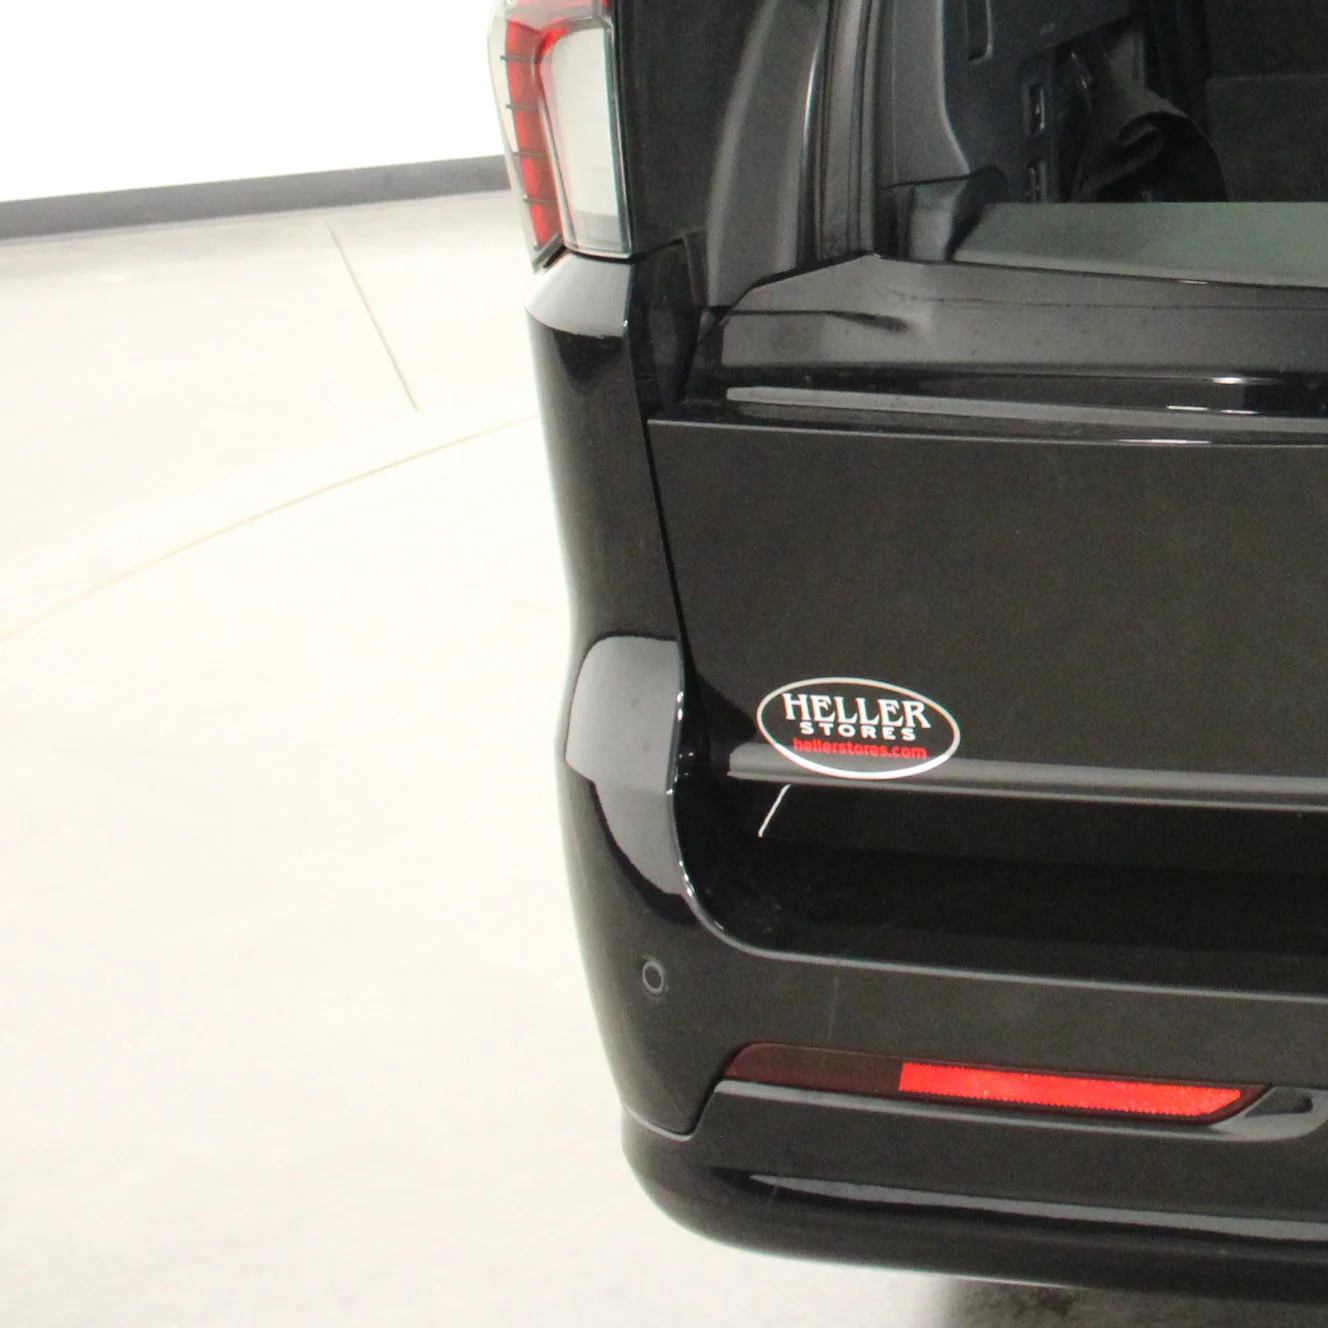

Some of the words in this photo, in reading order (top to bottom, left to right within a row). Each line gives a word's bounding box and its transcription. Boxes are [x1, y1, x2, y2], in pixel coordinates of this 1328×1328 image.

[782, 692, 931, 728] HELLER
[800, 721, 916, 741] STORES
[793, 737, 927, 759] hellerstores.com
